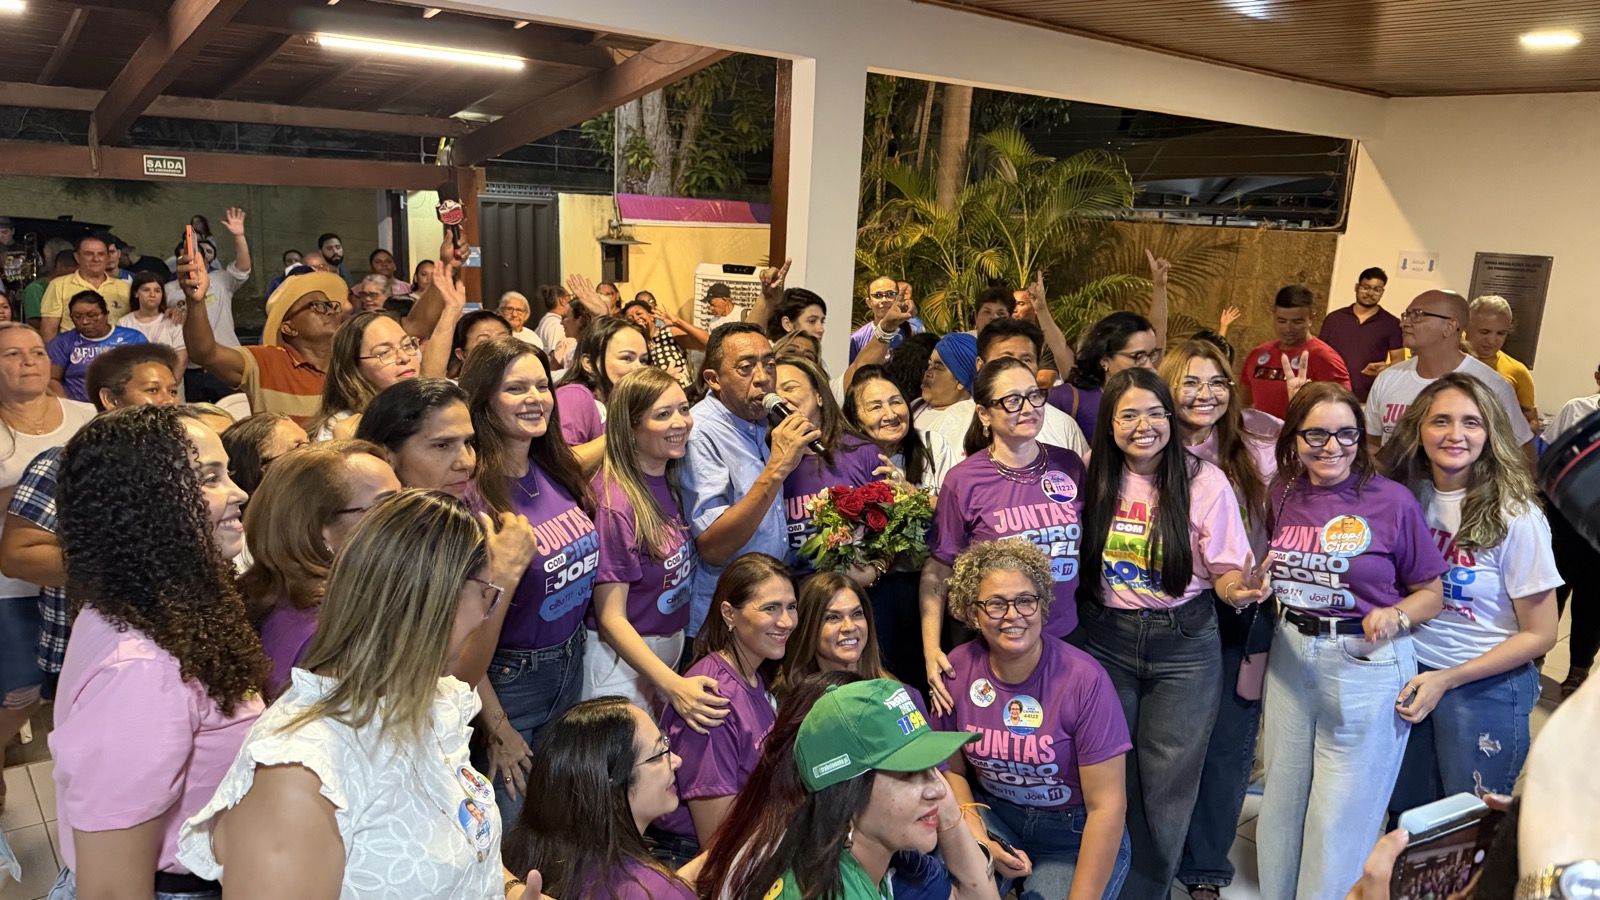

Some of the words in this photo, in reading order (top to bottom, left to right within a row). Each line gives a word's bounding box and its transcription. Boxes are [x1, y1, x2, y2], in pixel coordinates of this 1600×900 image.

[146, 159, 183, 170] SAÍDA
[993, 502, 1078, 534] JUNTAS
[533, 506, 596, 556] JUNTAS
[1115, 522, 1143, 533] COM
[1324, 541, 1358, 553] Ciro
[547, 555, 565, 570] COM
[666, 555, 681, 568] COM
[1286, 551, 1350, 573] CIRO
[1272, 565, 1350, 589] JOEL
[961, 724, 1056, 764] JUNTAS
[988, 759, 1059, 777] CIRO
